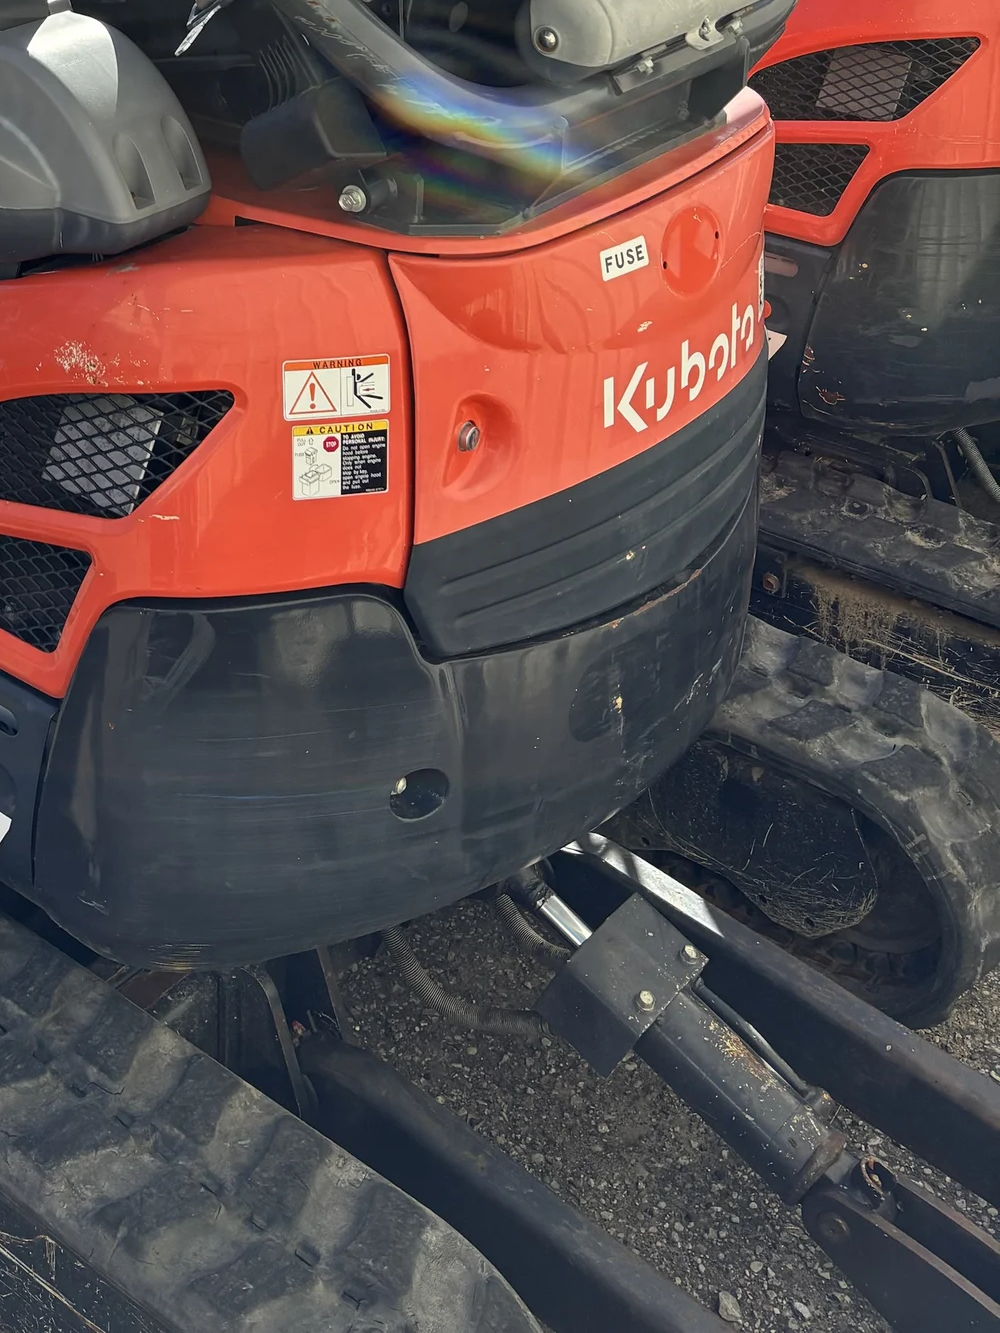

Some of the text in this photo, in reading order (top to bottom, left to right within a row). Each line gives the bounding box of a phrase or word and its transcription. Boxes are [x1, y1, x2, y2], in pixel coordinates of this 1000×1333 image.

[604, 244, 645, 273] FUSE
[313, 359, 362, 369] WARNING
[603, 302, 755, 433] Kubota
[319, 423, 374, 434] CAUTION
[342, 437, 366, 445] PERSONAL
